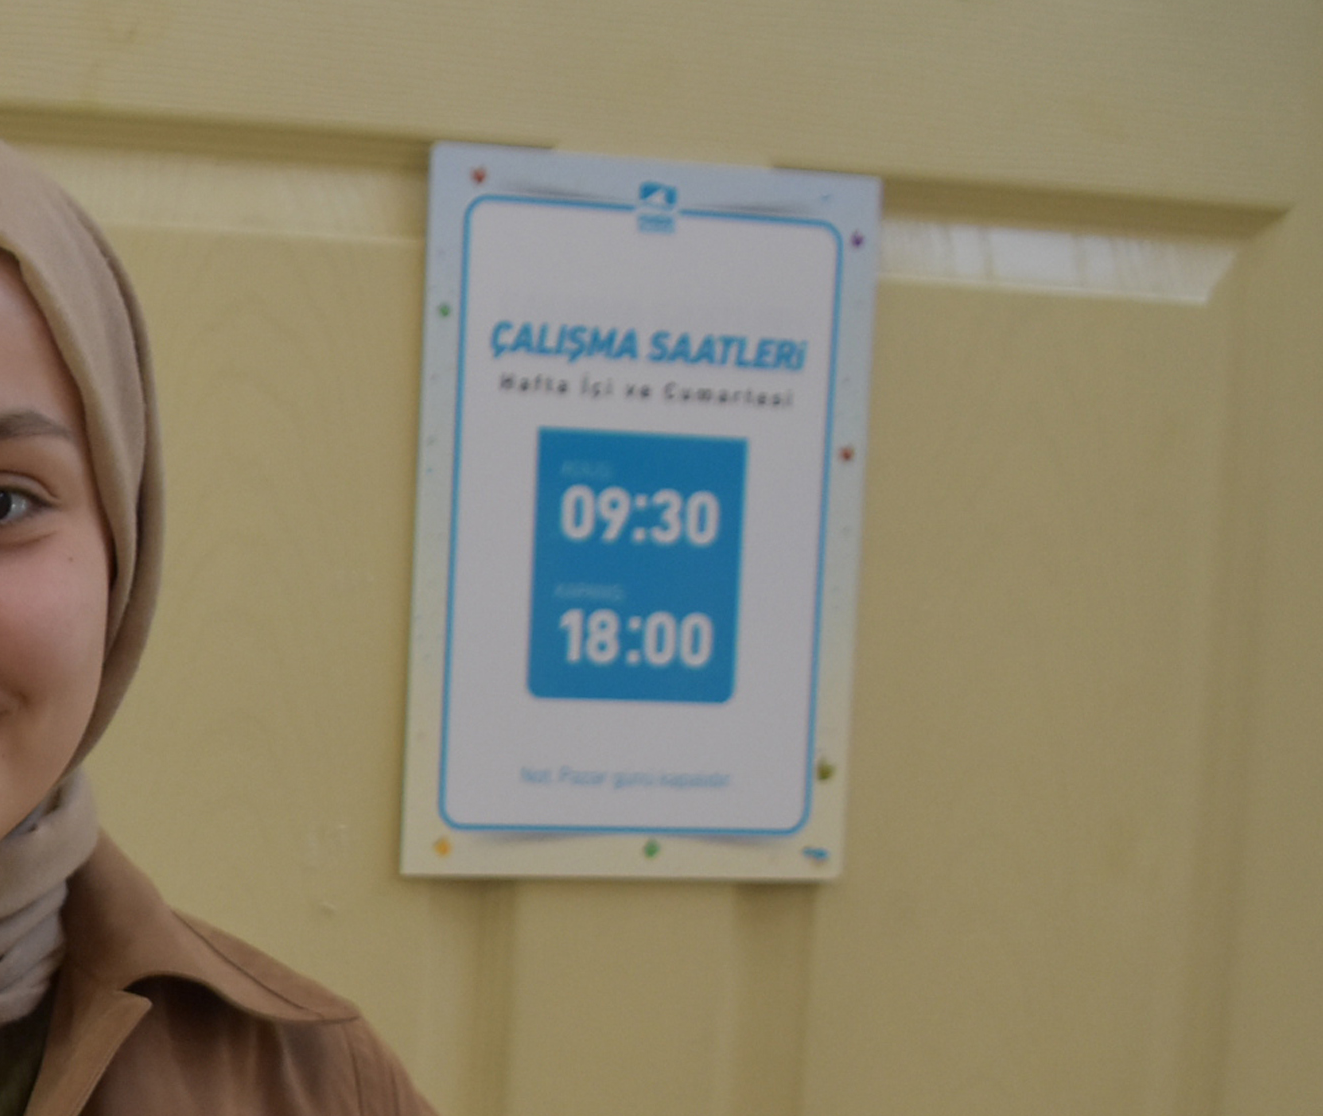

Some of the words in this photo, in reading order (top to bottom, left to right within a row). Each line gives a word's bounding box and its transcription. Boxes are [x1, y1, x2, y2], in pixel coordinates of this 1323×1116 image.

[489, 321, 640, 364] ÇALIŞMA
[561, 484, 720, 545] 09:30
[560, 607, 714, 668] 18:00
